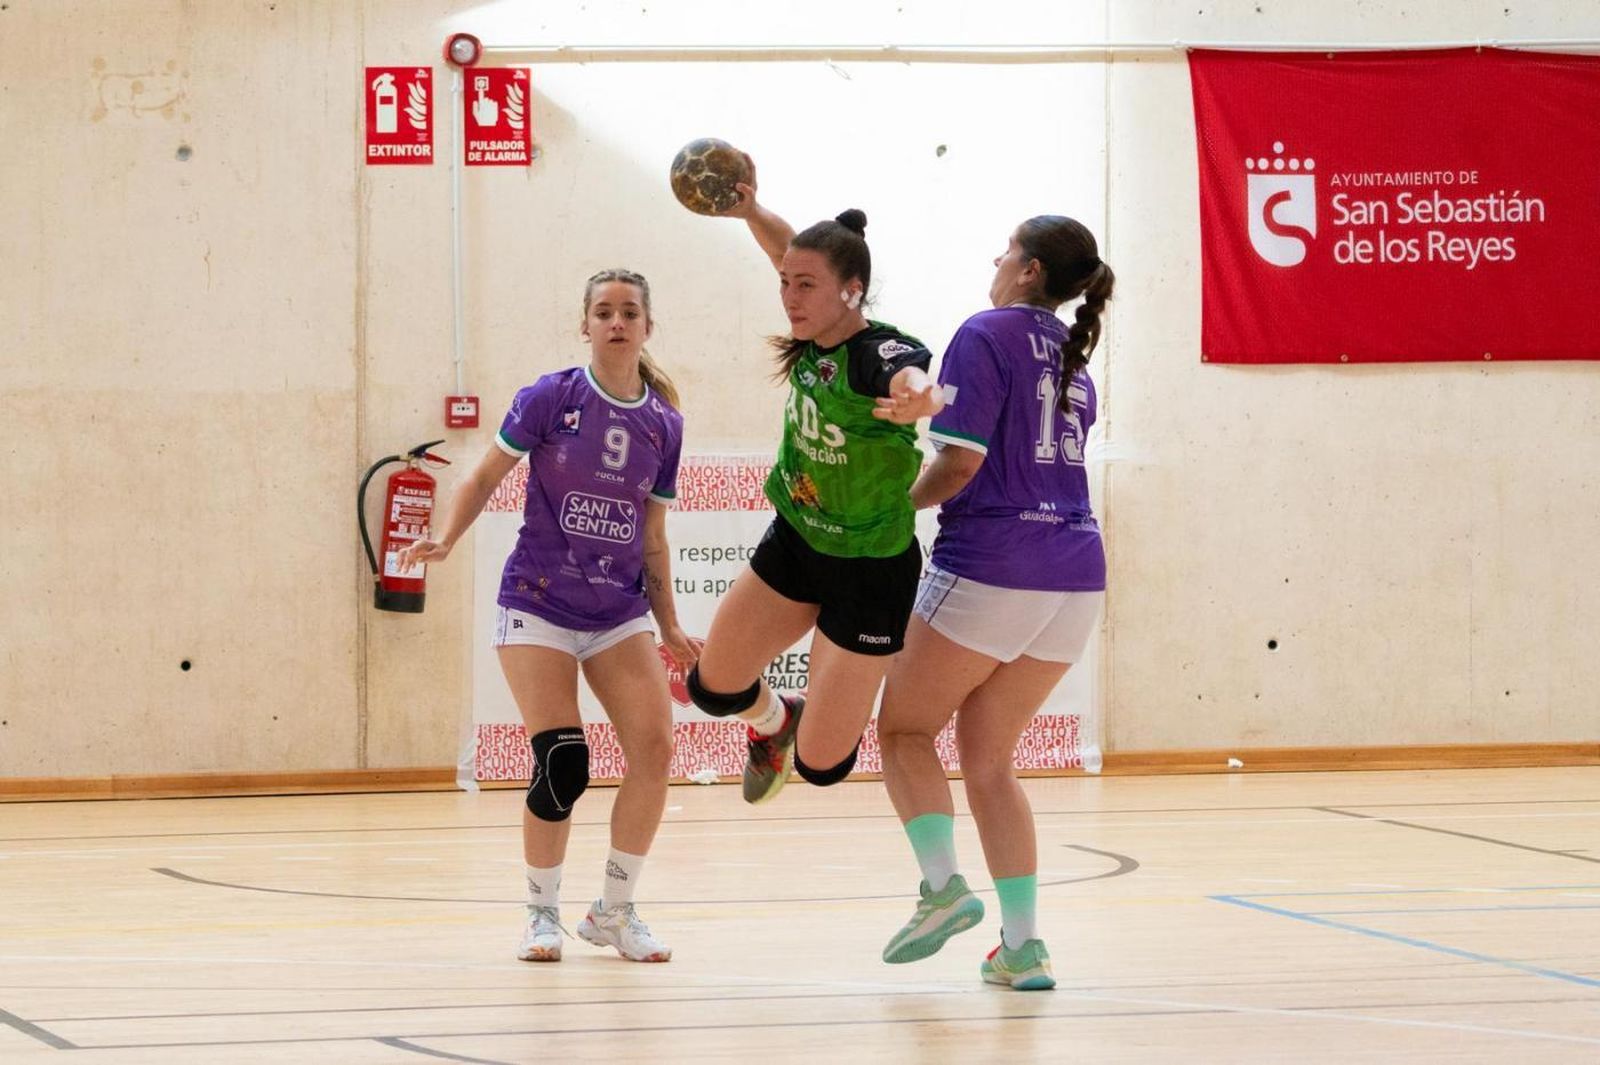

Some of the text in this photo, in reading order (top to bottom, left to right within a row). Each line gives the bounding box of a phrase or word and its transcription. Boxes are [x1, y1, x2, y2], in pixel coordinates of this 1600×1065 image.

[368, 144, 431, 157] EXTINTOR
[468, 151, 527, 161] DE ALARMA
[470, 141, 525, 150] PULSADOR
[1331, 170, 1478, 187] AYUNTAMIENTO DE
[1332, 190, 1545, 225] San Sebastián
[1333, 230, 1516, 269] de los Reyes
[1035, 368, 1087, 466] 15
[602, 426, 630, 470] 9
[569, 496, 610, 518] SANI
[565, 514, 633, 540] CENTRO
[680, 543, 757, 565] respeto
[674, 577, 696, 594] tu
